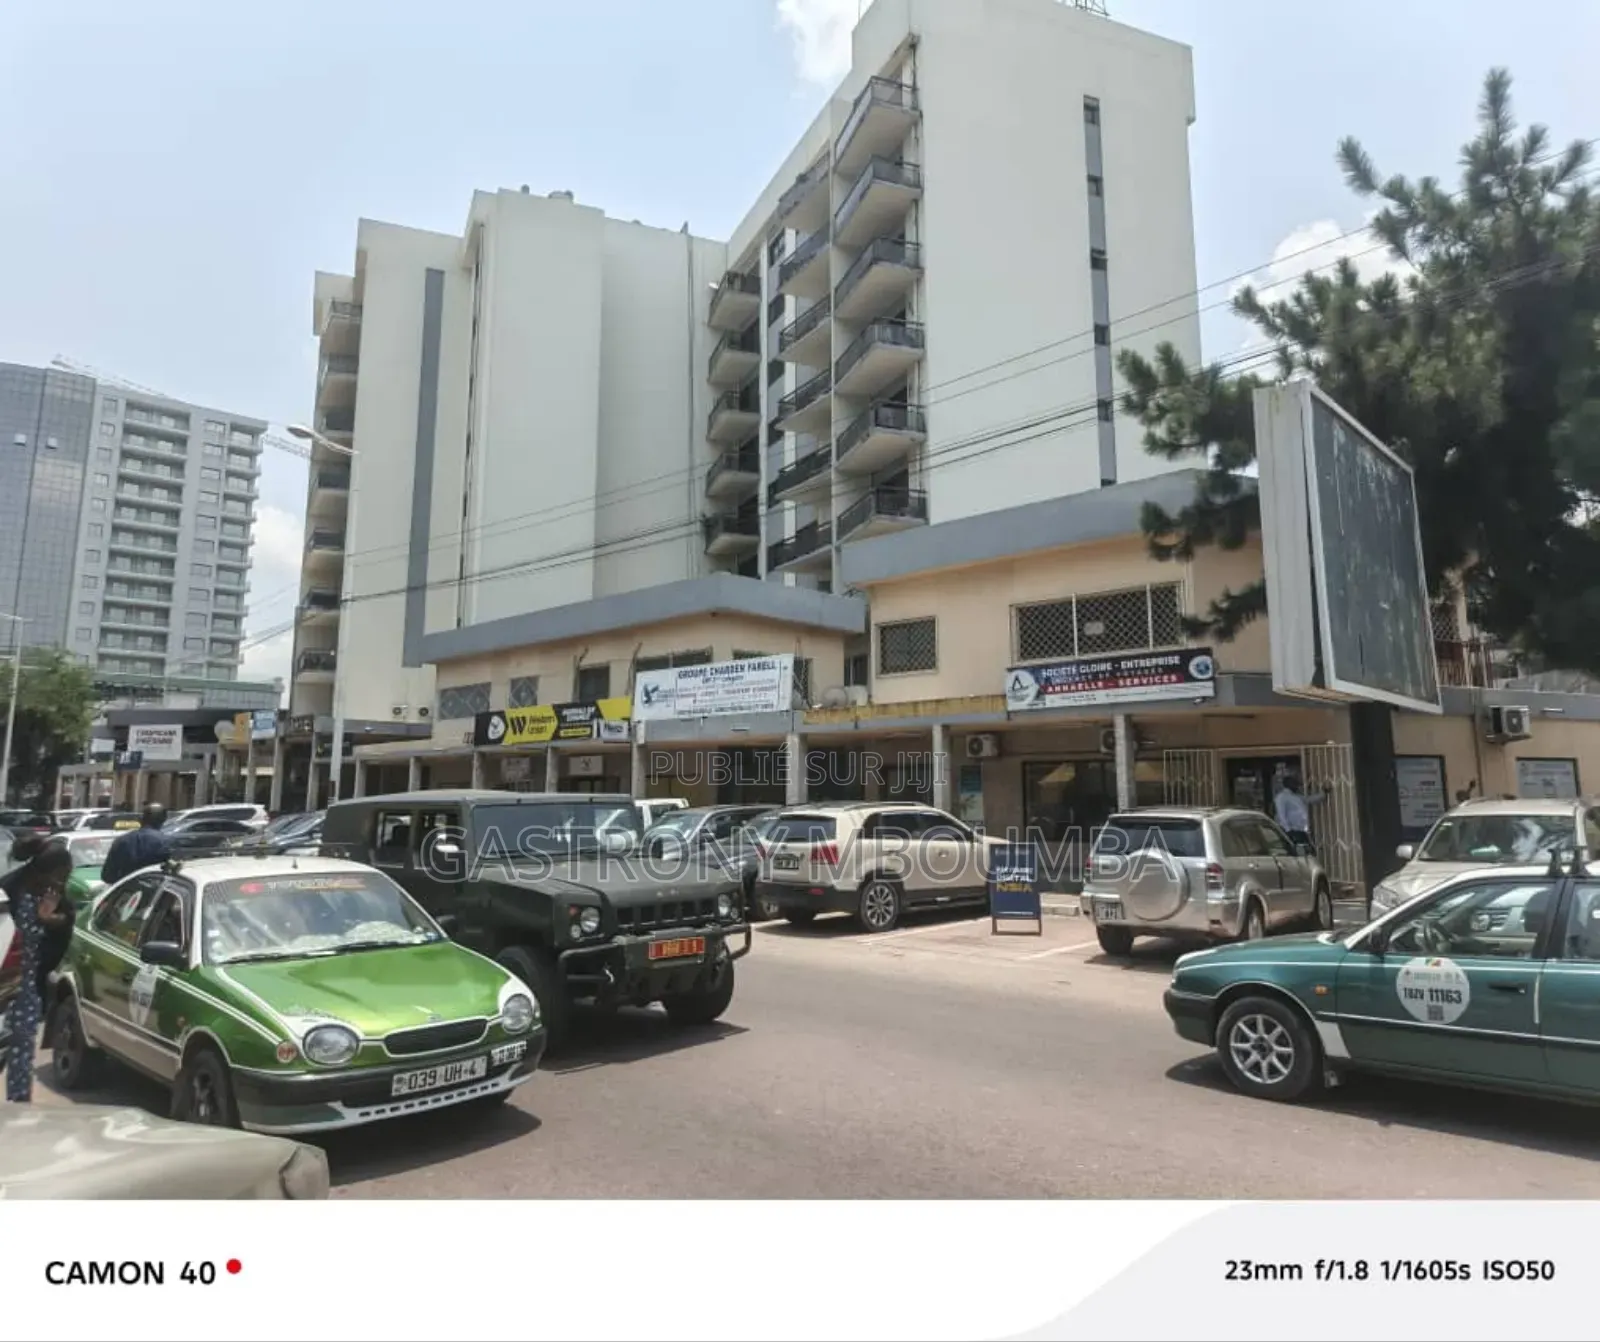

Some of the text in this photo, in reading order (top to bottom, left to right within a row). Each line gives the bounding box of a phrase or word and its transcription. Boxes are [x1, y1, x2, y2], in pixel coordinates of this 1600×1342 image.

[1120, 656, 1181, 669] ENTREPRISE
[678, 668, 707, 679] GROUPE
[1047, 680, 1104, 693] ANNAELLE
[1118, 674, 1178, 687] SERVICES
[1428, 987, 1462, 1004] 11163
[407, 1070, 437, 1091] 039
